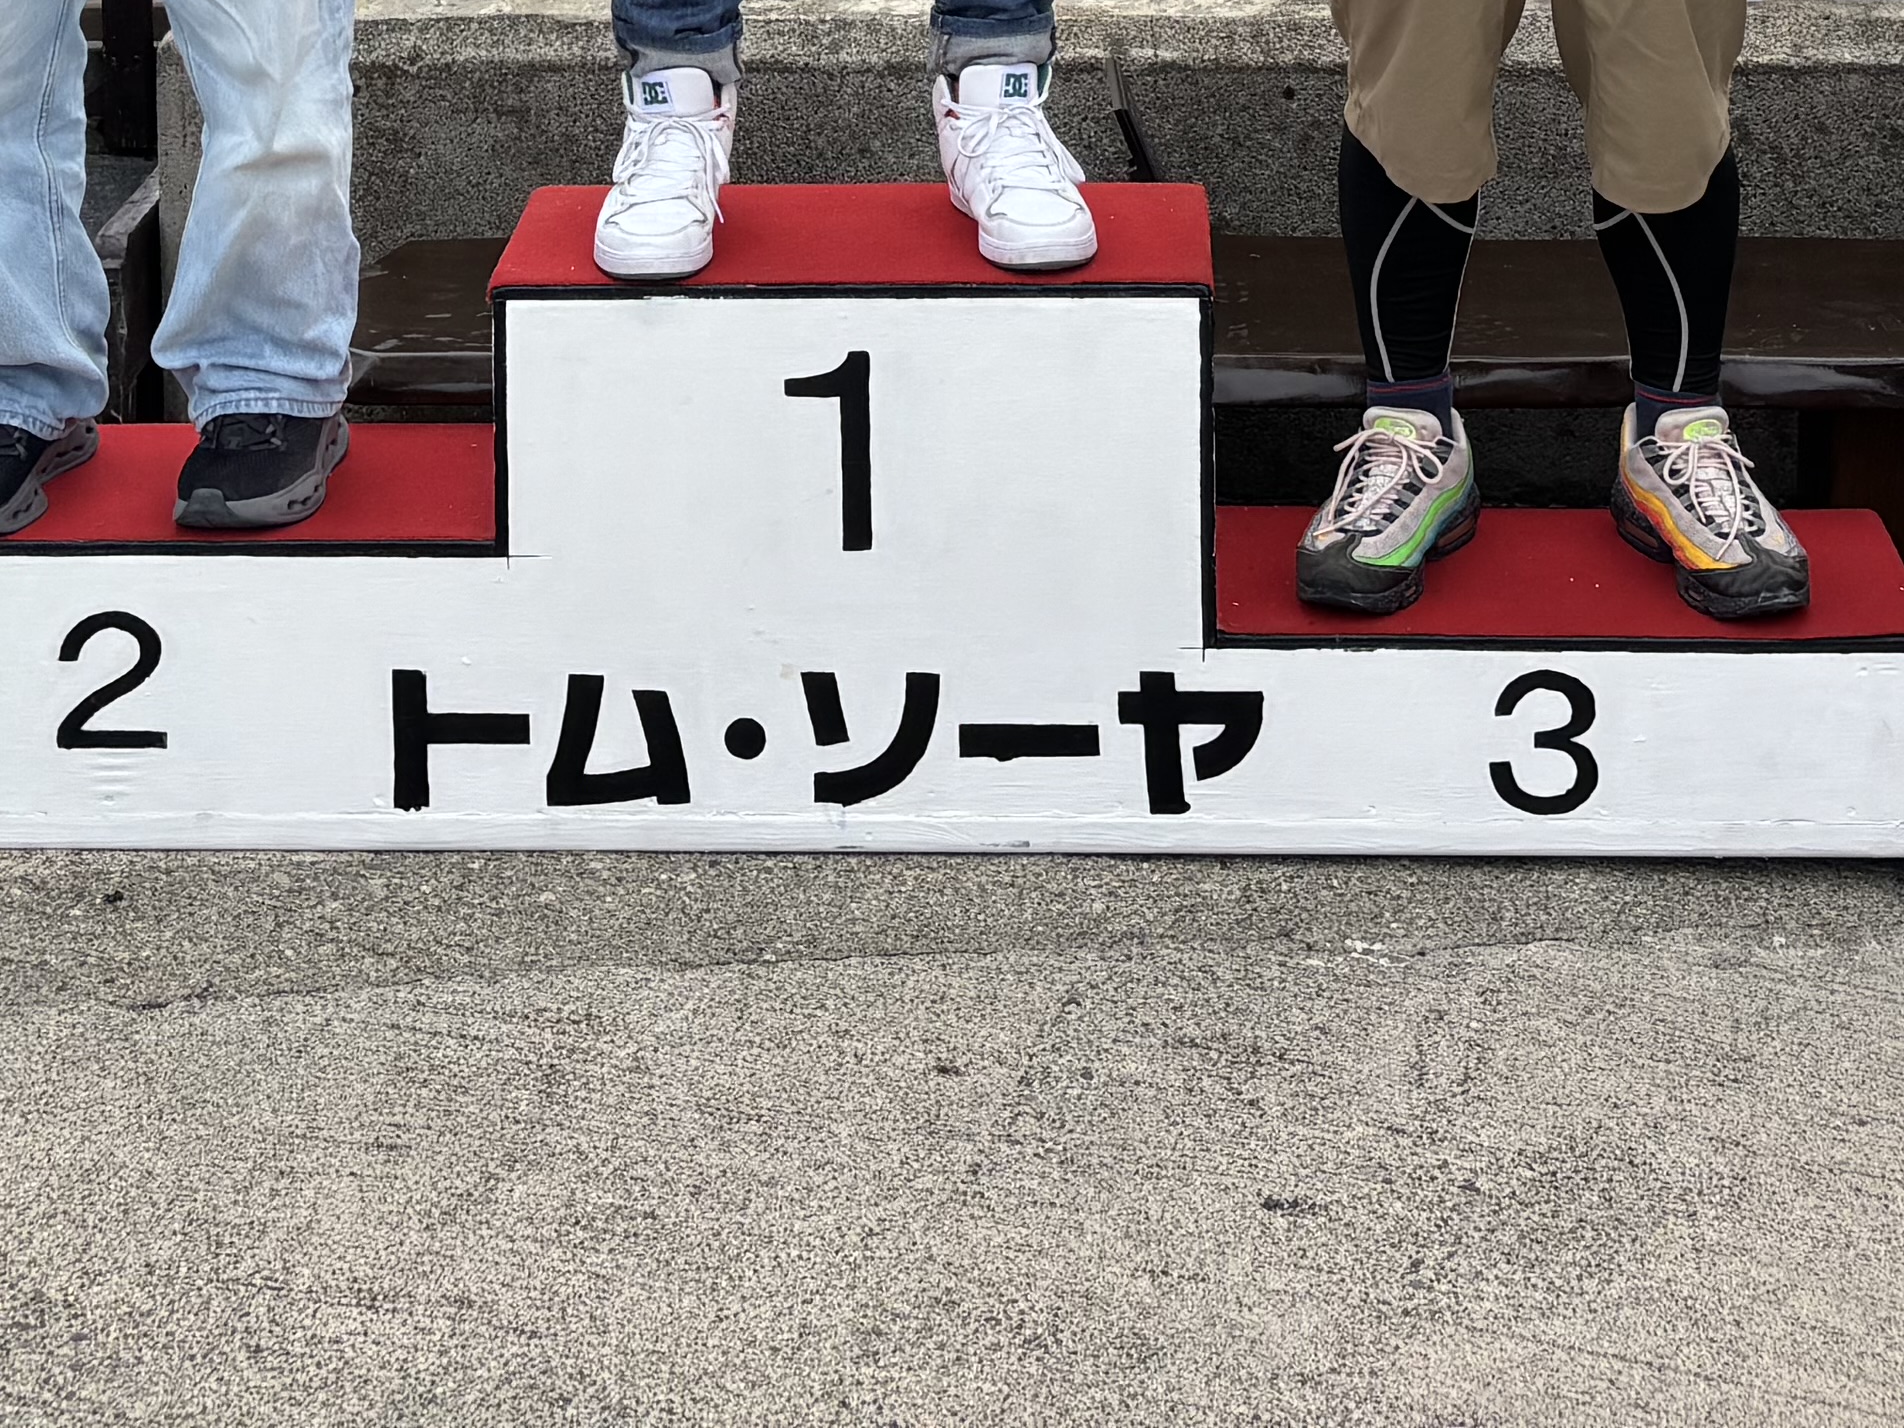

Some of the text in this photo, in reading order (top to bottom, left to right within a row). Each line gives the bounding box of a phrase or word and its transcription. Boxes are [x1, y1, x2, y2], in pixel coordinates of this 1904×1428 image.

[784, 348, 873, 552] 1
[55, 609, 169, 751] 2
[390, 667, 1264, 816] トム・ソーヤ
[1487, 669, 1600, 815] 3
